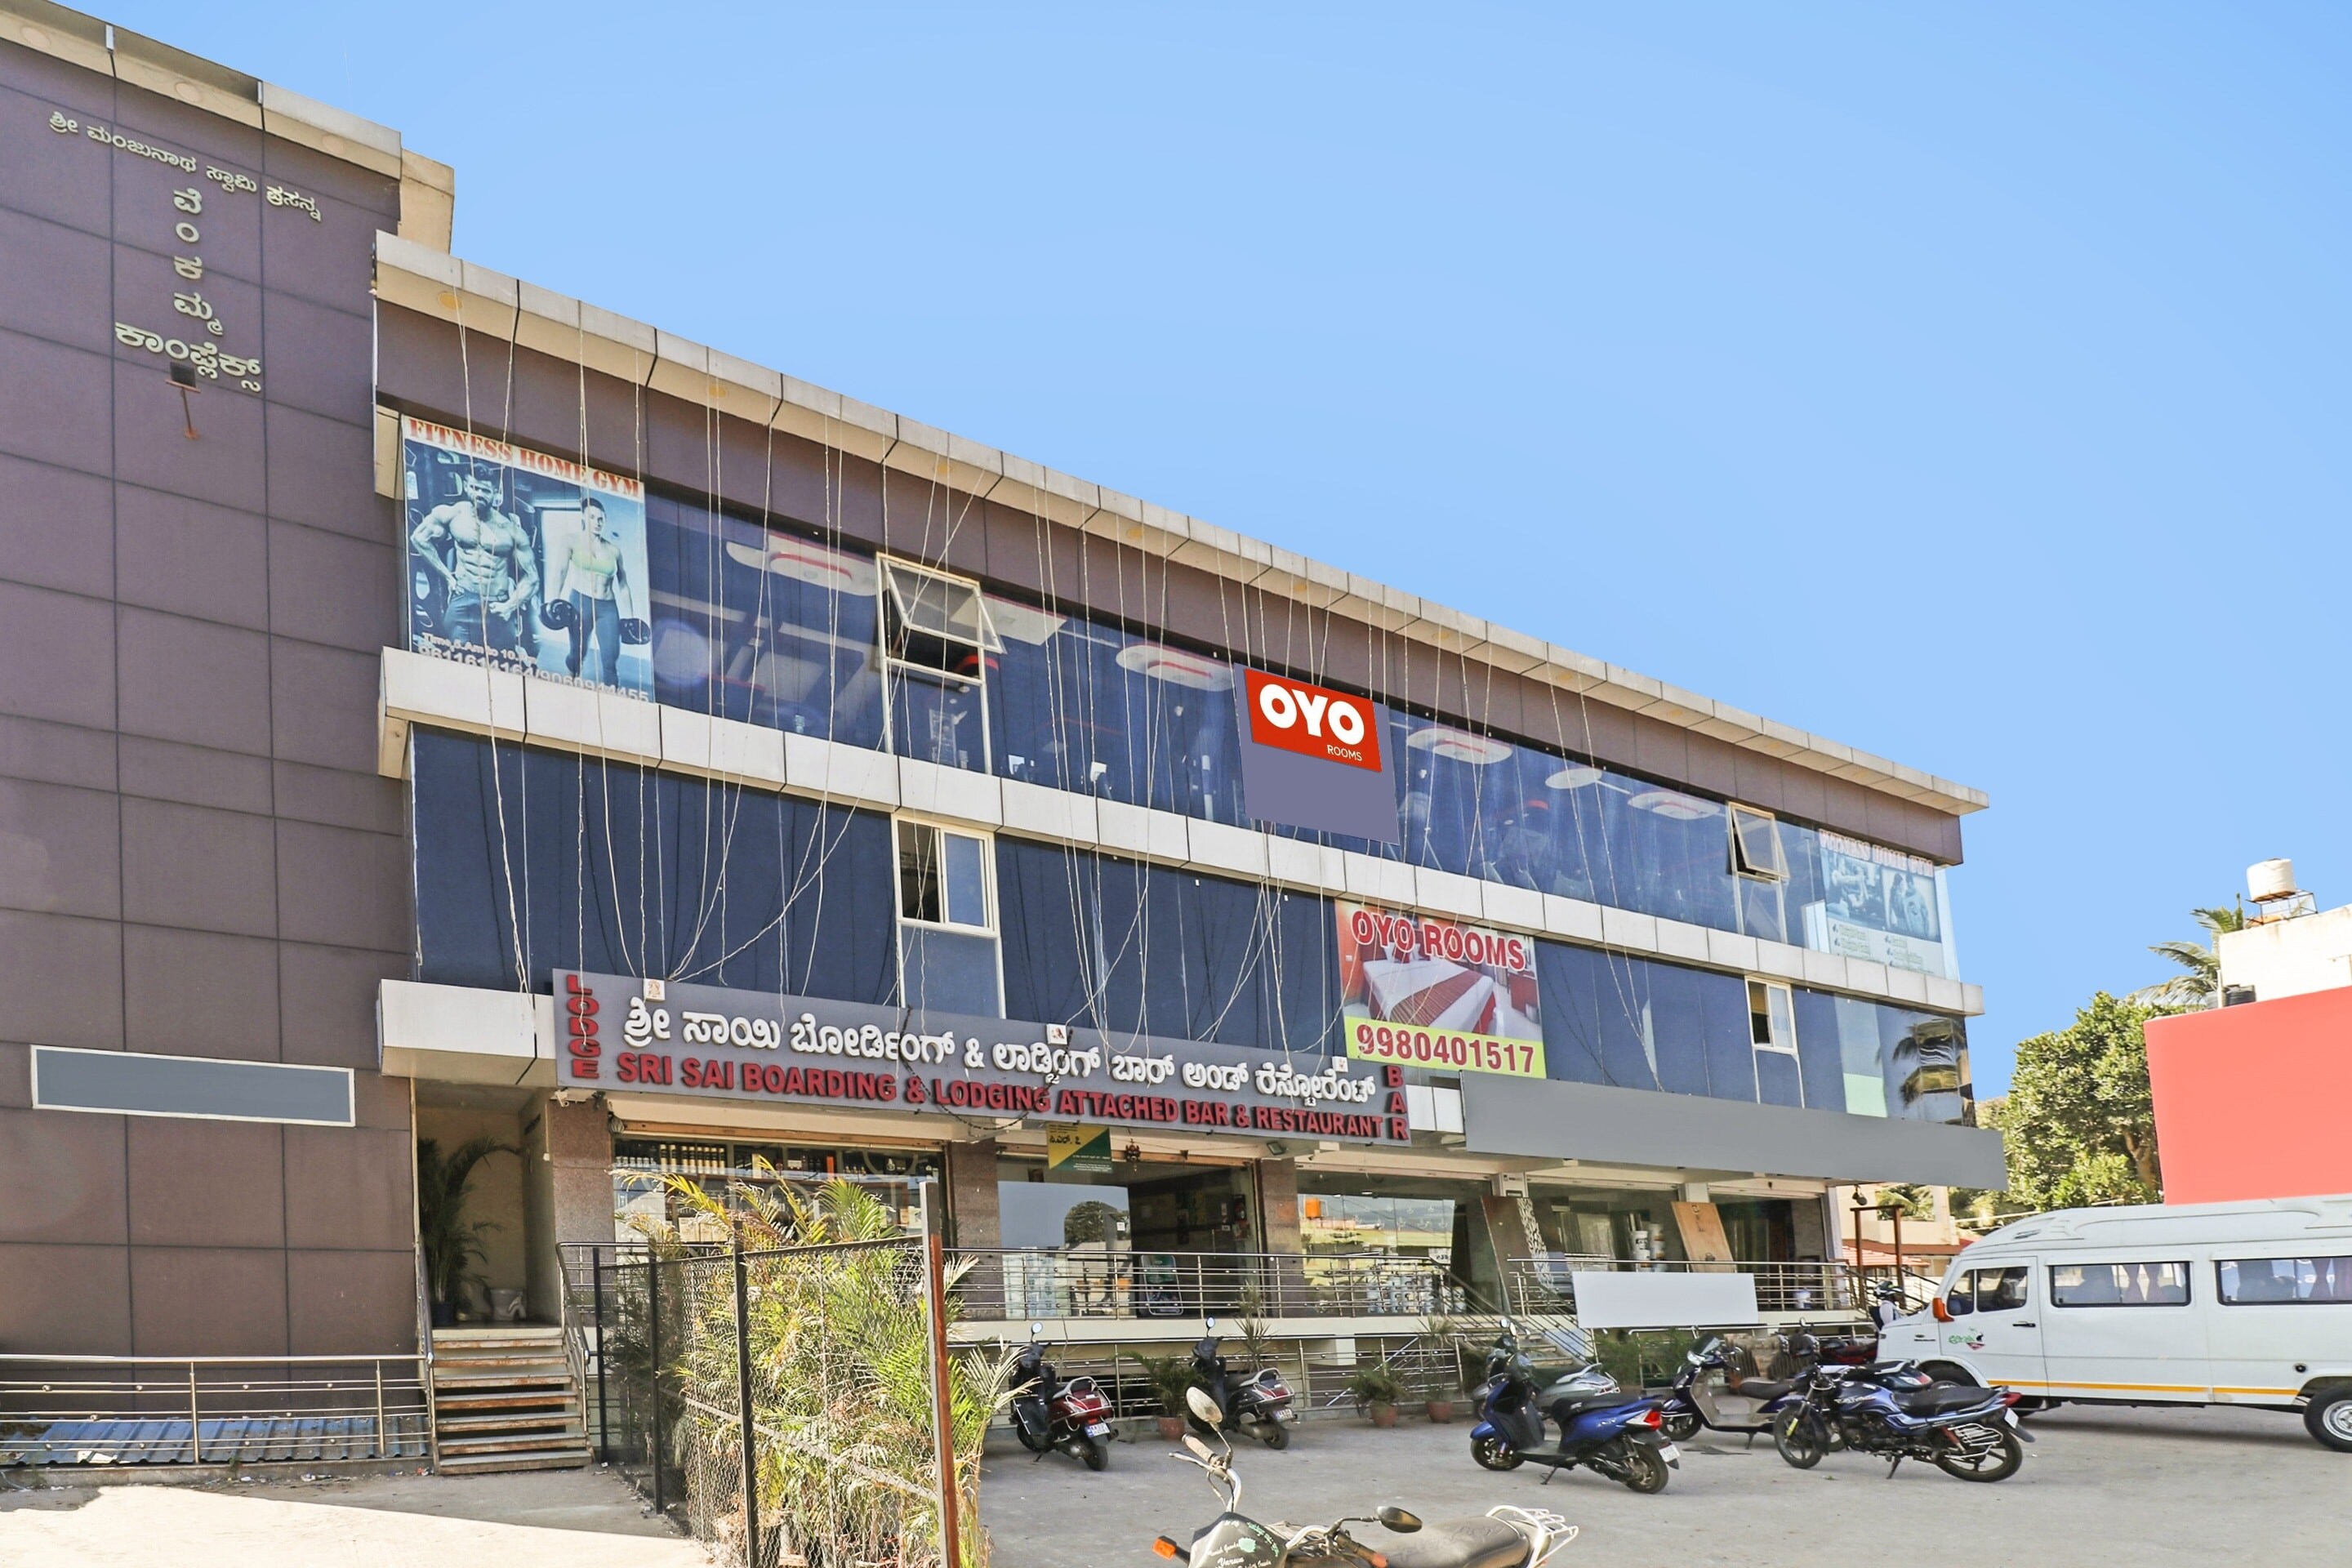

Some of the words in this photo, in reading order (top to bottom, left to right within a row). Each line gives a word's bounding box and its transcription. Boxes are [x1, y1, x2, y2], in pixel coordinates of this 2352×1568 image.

[49, 110, 78, 135] ಶ್ರೀ
[87, 125, 197, 173] ಮಂಜುನಾಥ
[206, 163, 257, 194] ಸ್ವಾಮಿ
[266, 185, 322, 222] ಪ್ರಸನ್ನ
[409, 419, 512, 462] FITNESS
[519, 448, 588, 483] HOME
[592, 470, 639, 497] GYM
[1259, 684, 1365, 746] OYO
[1327, 744, 1362, 762] ROOMS
[1351, 910, 1415, 952] OYO
[1423, 923, 1526, 972] ROOMS
[566, 974, 601, 1079] LODGE
[624, 996, 671, 1048] ಶ್ರೀ
[682, 1011, 782, 1049] ಸಾಯಿ
[964, 1037, 986, 1068] &
[1111, 1054, 1175, 1085] ಬಾರ್
[1182, 1062, 1250, 1092] ಅಂಡ್
[1356, 1023, 1535, 1074] 9980401517
[617, 1052, 673, 1085] SRI
[682, 1057, 734, 1089] SAI
[742, 1062, 897, 1102] BOARDING
[906, 1076, 926, 1104] &
[933, 1078, 1051, 1112] LODGING
[1057, 1089, 1178, 1123] ATTACHED
[1185, 1099, 1230, 1125] BAR
[1236, 1104, 1250, 1128] &
[1254, 1106, 1383, 1138] RESTAURANT
[1386, 1065, 1409, 1140] BAR
